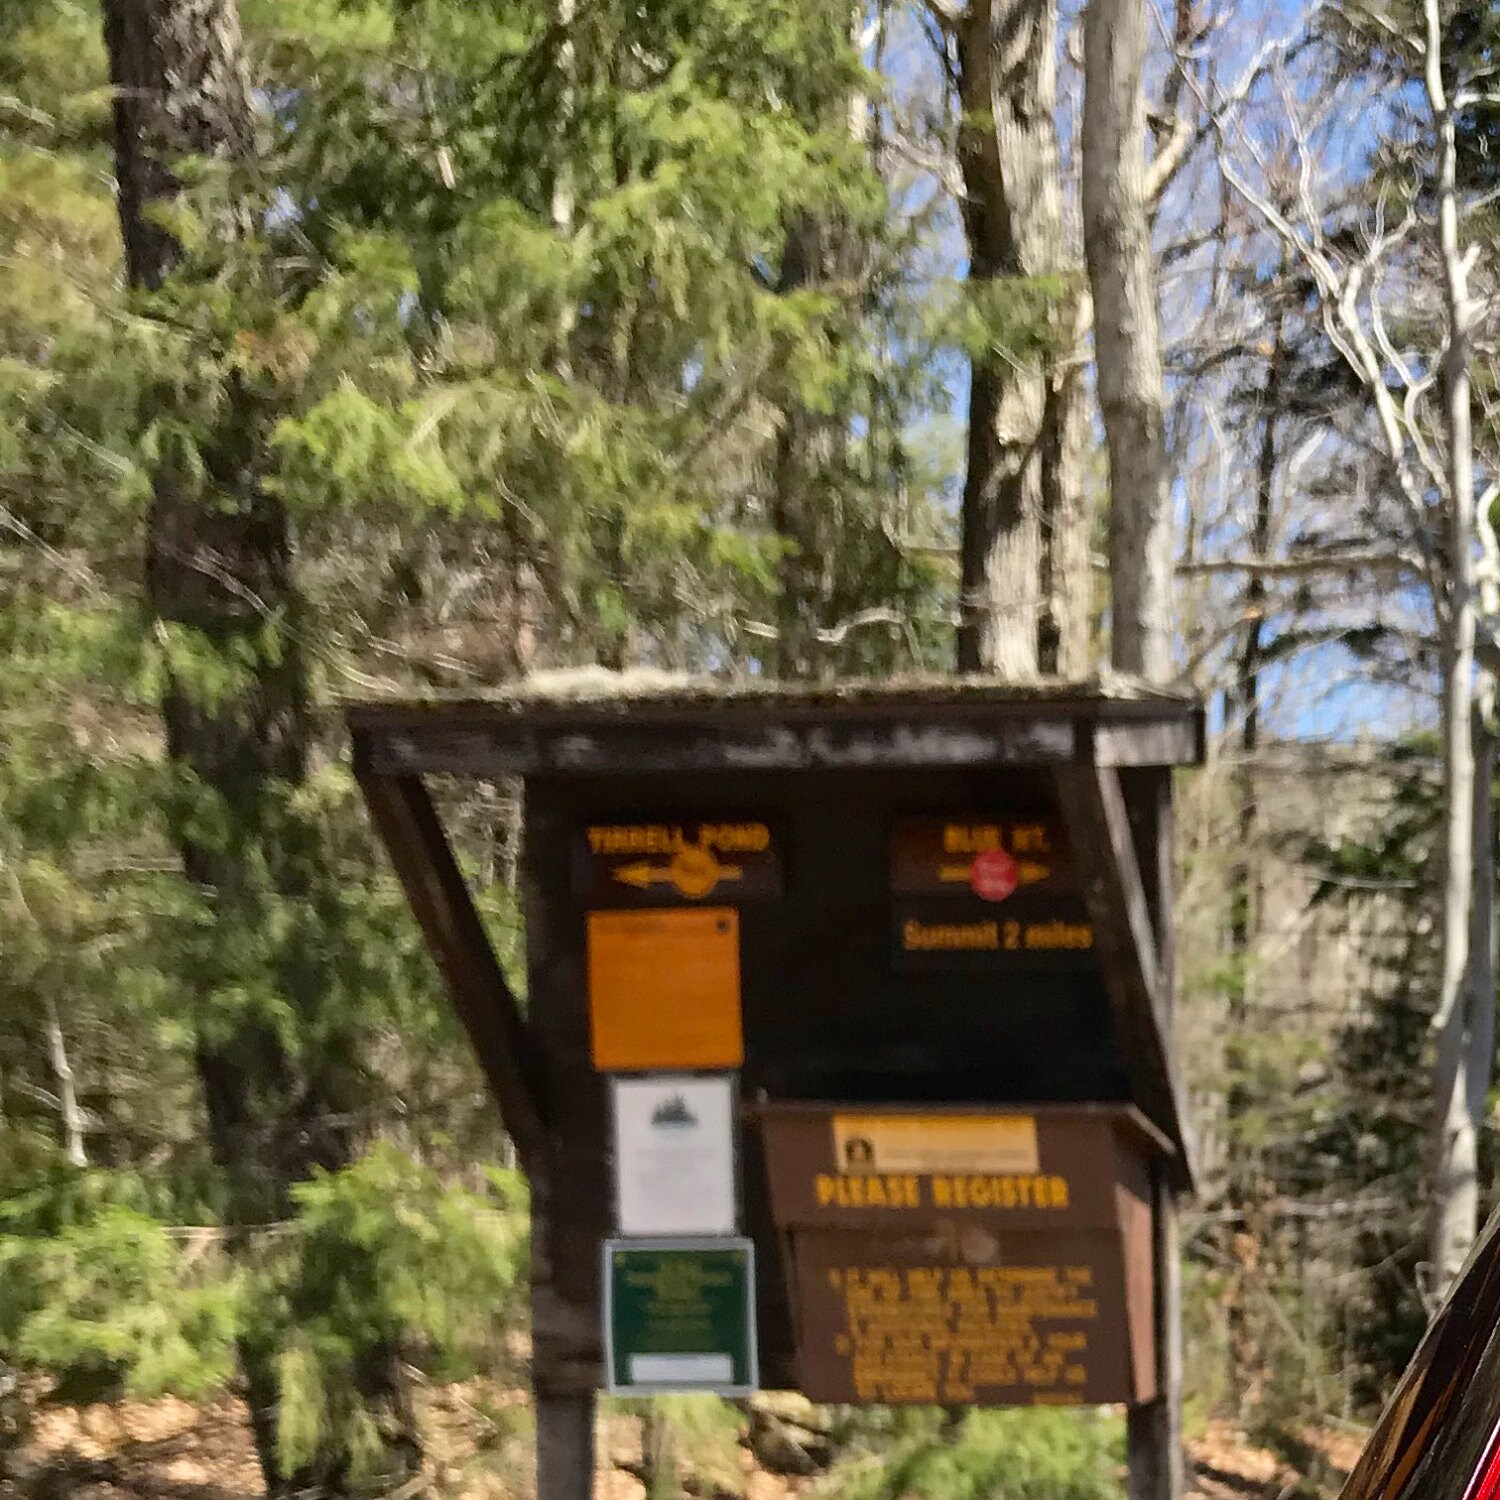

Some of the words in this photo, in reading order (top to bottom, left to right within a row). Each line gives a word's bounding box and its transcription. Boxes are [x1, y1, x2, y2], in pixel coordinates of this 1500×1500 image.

[1004, 921, 1019, 949] 2
[816, 1173, 918, 1208] PLEASE
[932, 1173, 1068, 1210] REGISTER
